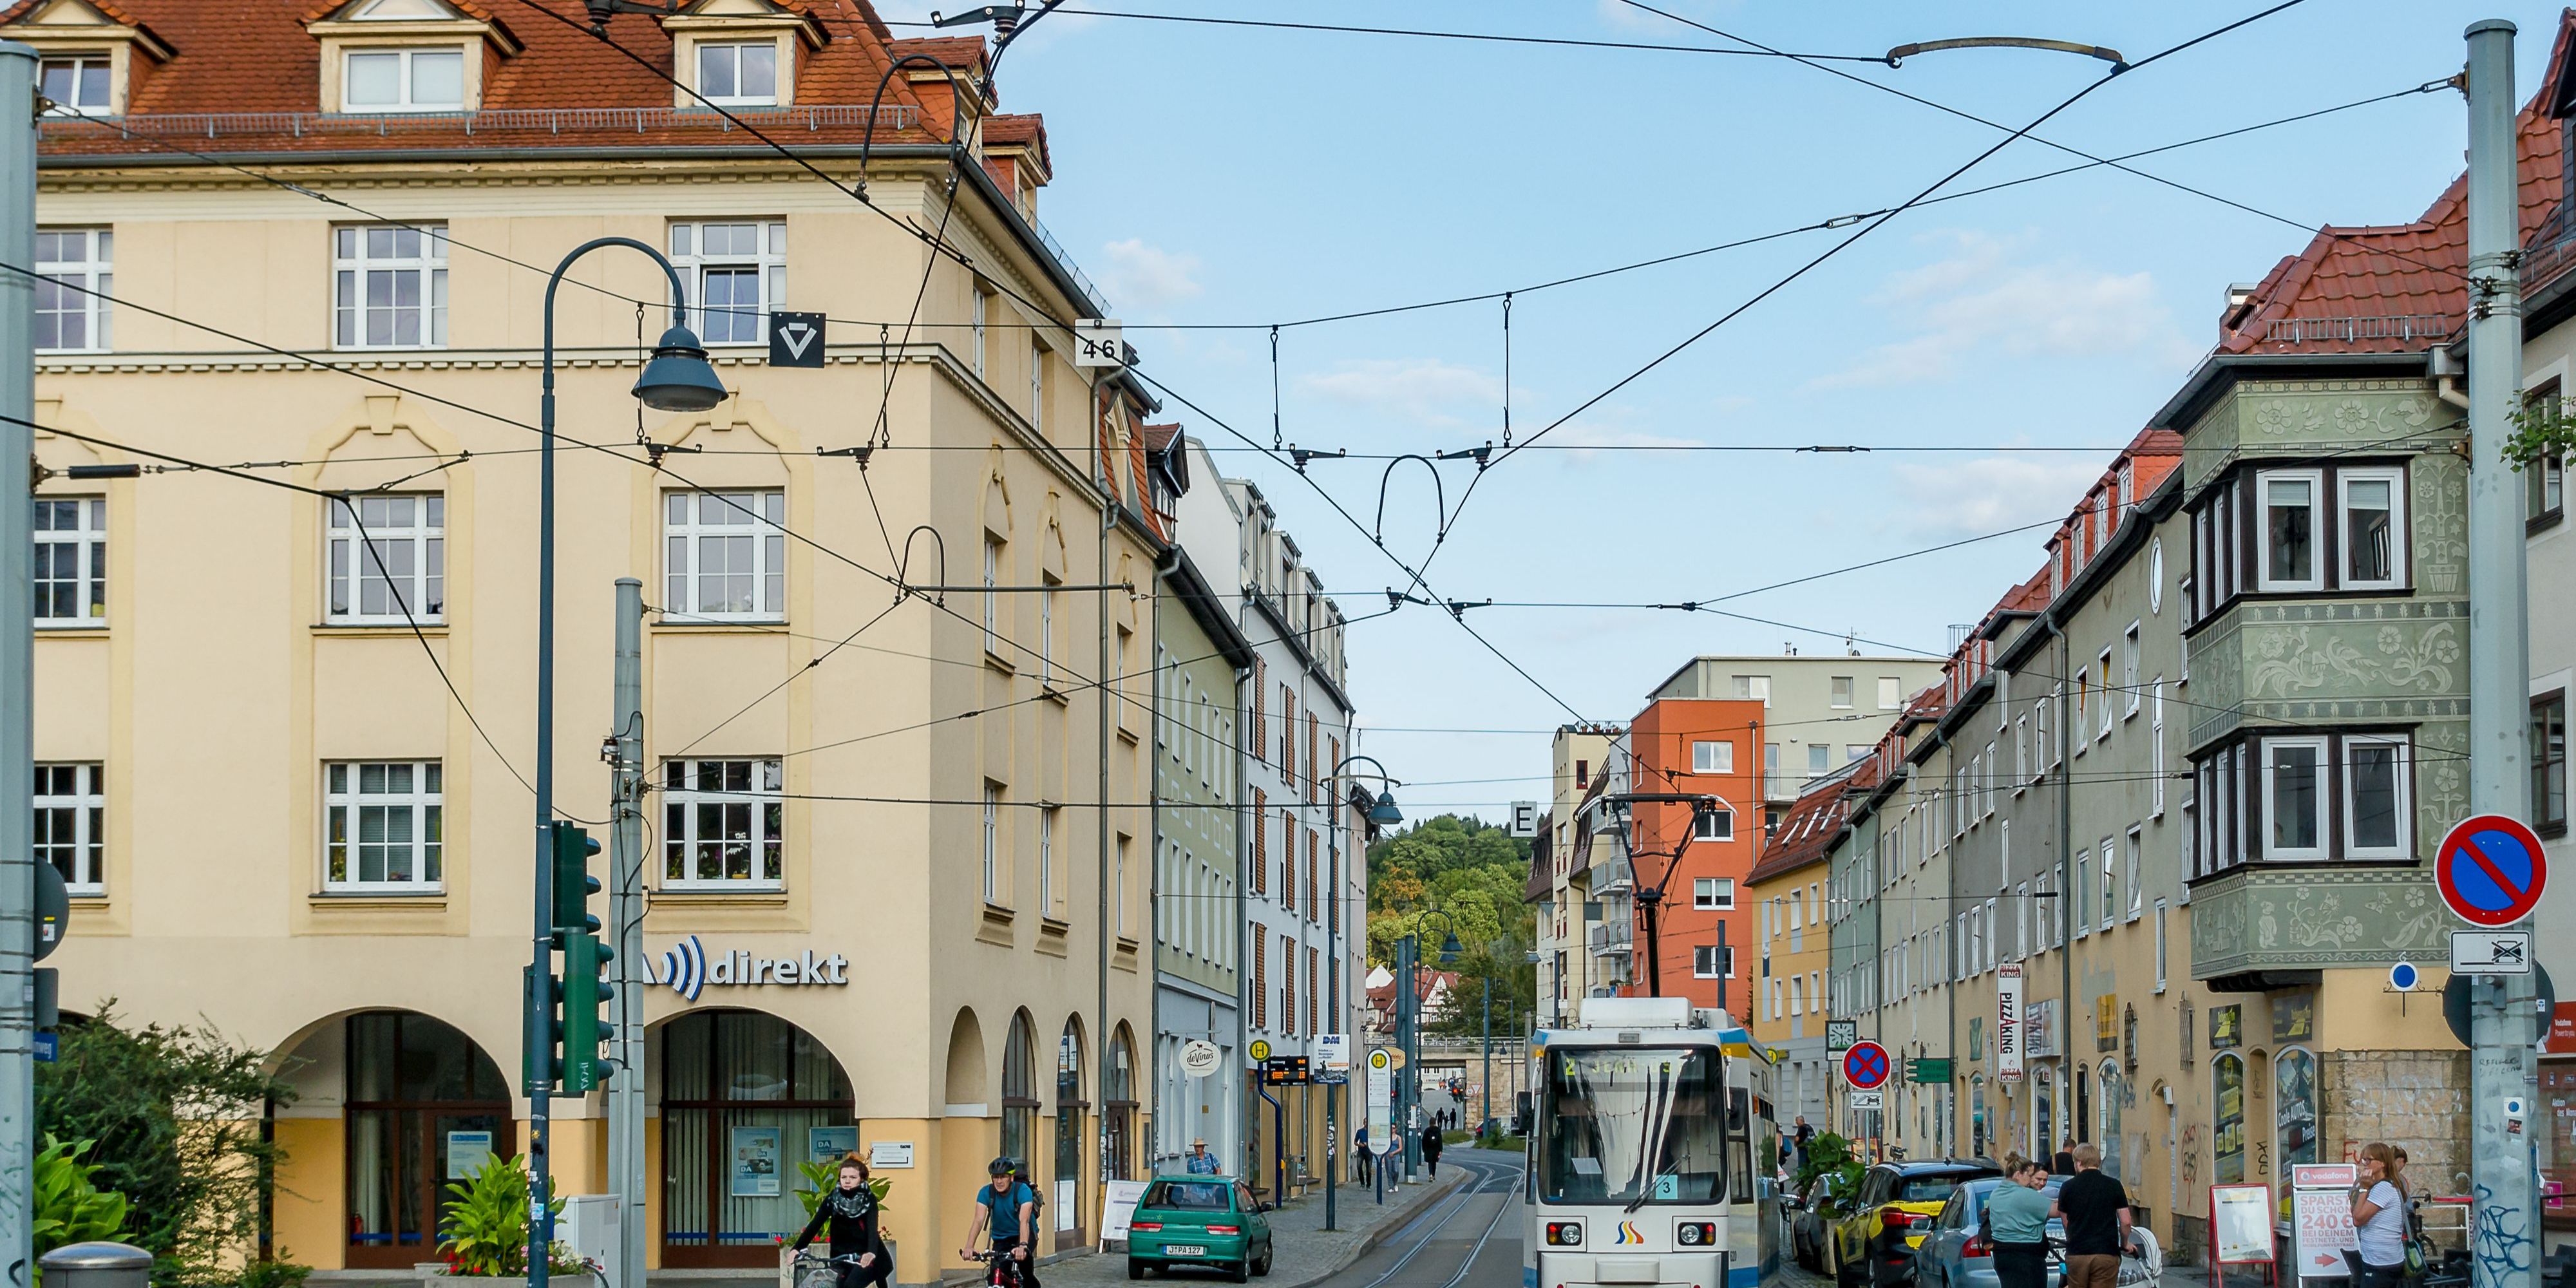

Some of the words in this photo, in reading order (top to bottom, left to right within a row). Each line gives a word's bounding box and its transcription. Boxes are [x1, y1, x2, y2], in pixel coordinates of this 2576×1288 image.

[1083, 339, 1115, 359] 46
[1516, 806, 1532, 831] E
[709, 950, 848, 985] direkt
[1255, 1045, 1264, 1056] H
[1376, 1056, 1383, 1065] H
[1566, 1057, 1575, 1075] 2
[2312, 1171, 2349, 1180] vodafone
[1663, 1182, 1671, 1193] 3
[2300, 1195, 2350, 1206] SPARST
[2302, 1215, 2338, 1229] 240
[2341, 1215, 2353, 1229] €
